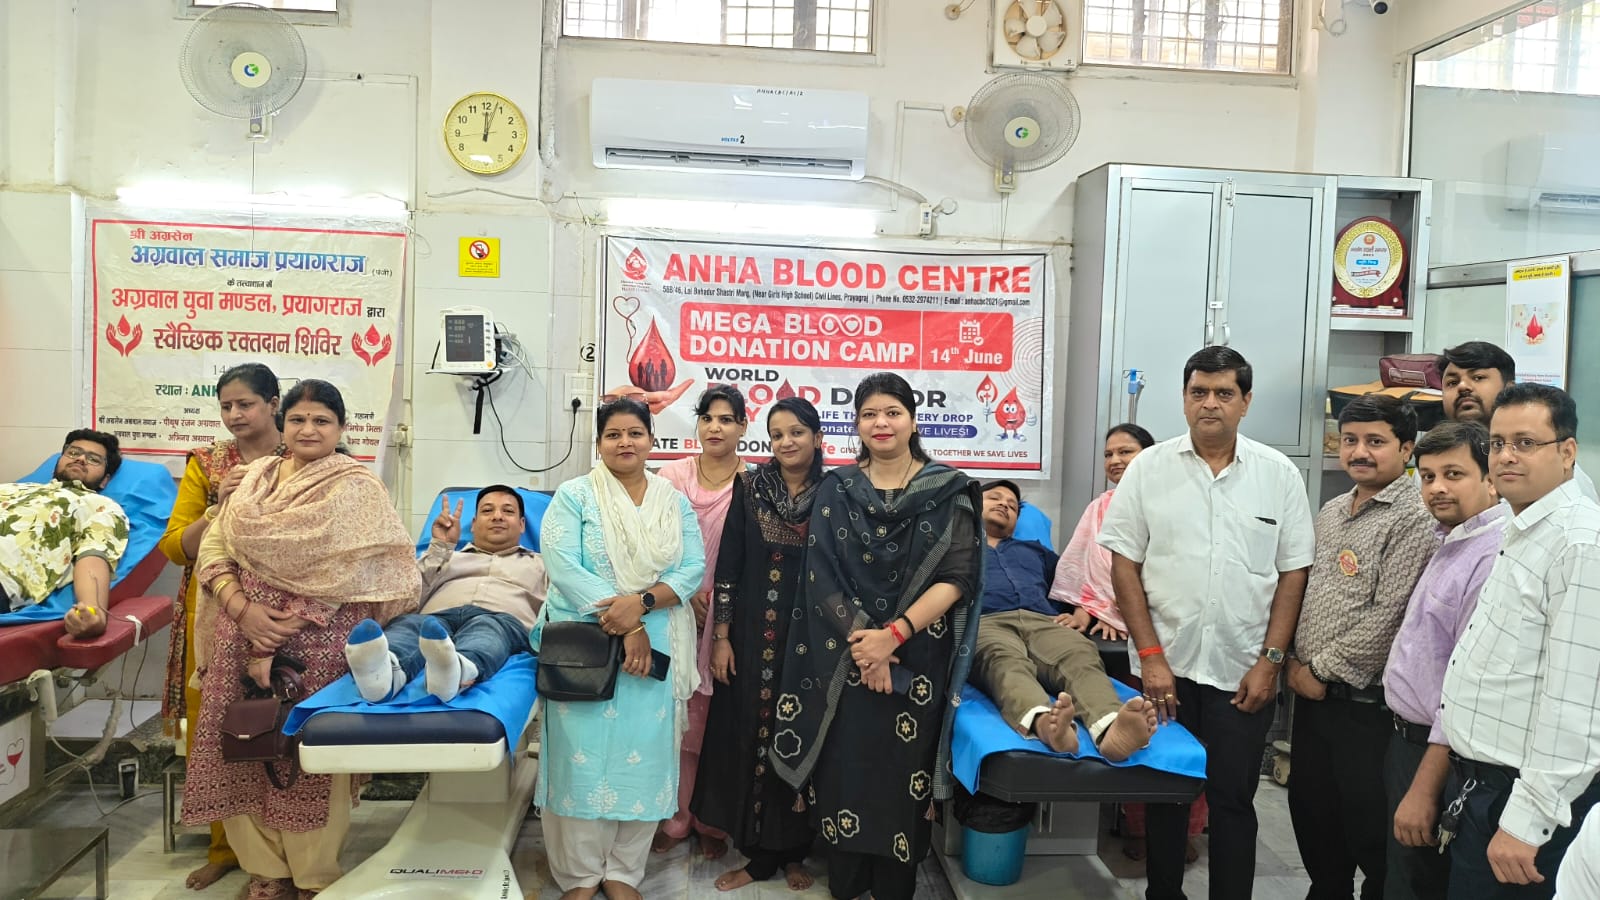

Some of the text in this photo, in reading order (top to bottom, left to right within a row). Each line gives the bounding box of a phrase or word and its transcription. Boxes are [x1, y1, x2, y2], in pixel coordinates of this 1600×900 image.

[740, 134, 745, 144] 2
[130, 228, 193, 242] श्री अग्रसेन
[131, 245, 205, 266] अग्रवाल
[210, 248, 269, 269] समाज
[275, 250, 366, 273] प्रयागराज
[663, 254, 1031, 294] ANHA BLOOD CENTRE
[684, 287, 692, 295] Lal
[694, 288, 715, 296] Bahadur
[716, 288, 734, 297] Shastri
[768, 290, 780, 298] Girls
[782, 291, 793, 300] High
[794, 291, 814, 300] School)
[815, 292, 826, 300] Civil
[844, 293, 869, 303] Prayagraj
[876, 294, 891, 303] Phone
[111, 288, 178, 310] अग्रवाल
[183, 290, 214, 318] युवा
[282, 294, 362, 318] प्रयागराज
[690, 310, 772, 334] MEGA
[153, 321, 342, 356] स्वैच्छिक रक्तदान शिविर
[690, 336, 915, 363] DONATION CAMP
[964, 350, 1003, 365] June
[705, 367, 780, 382] WORLD
[819, 411, 839, 419] IFE
[943, 414, 973, 422] DROP
[934, 428, 969, 436] LIVES!
